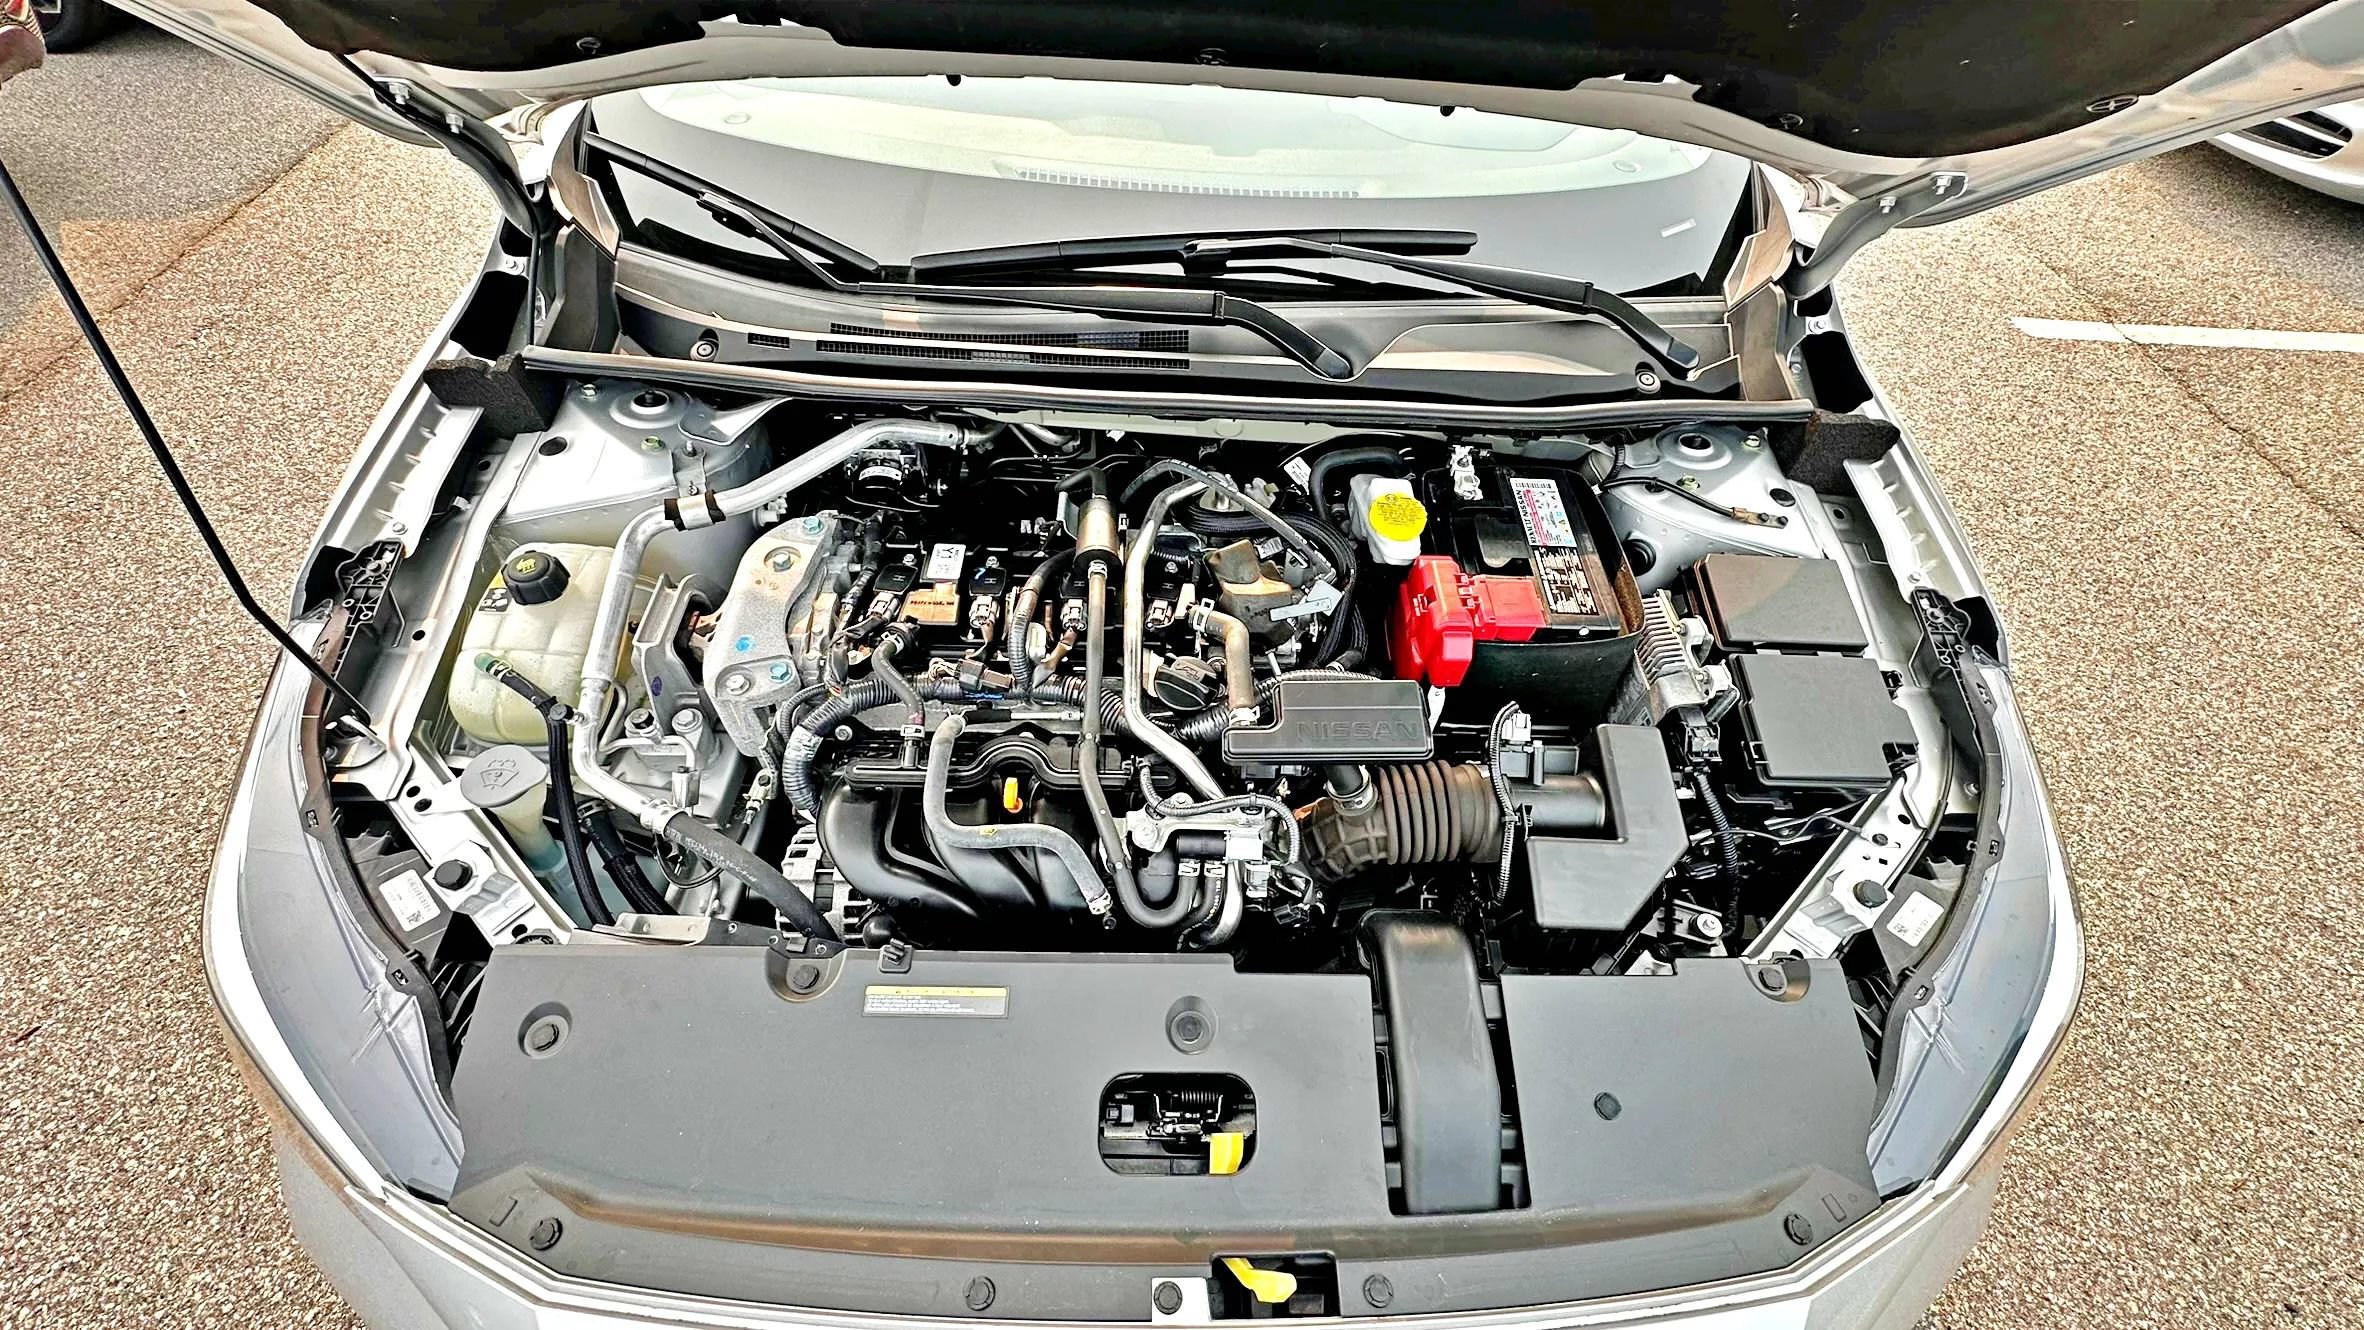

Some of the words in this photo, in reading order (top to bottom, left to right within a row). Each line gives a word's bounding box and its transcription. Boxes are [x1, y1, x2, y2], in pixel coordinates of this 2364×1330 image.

[1515, 489, 1529, 517] NISSAN
[940, 546, 955, 559] Y1
[1296, 720, 1419, 742] NISSAN
